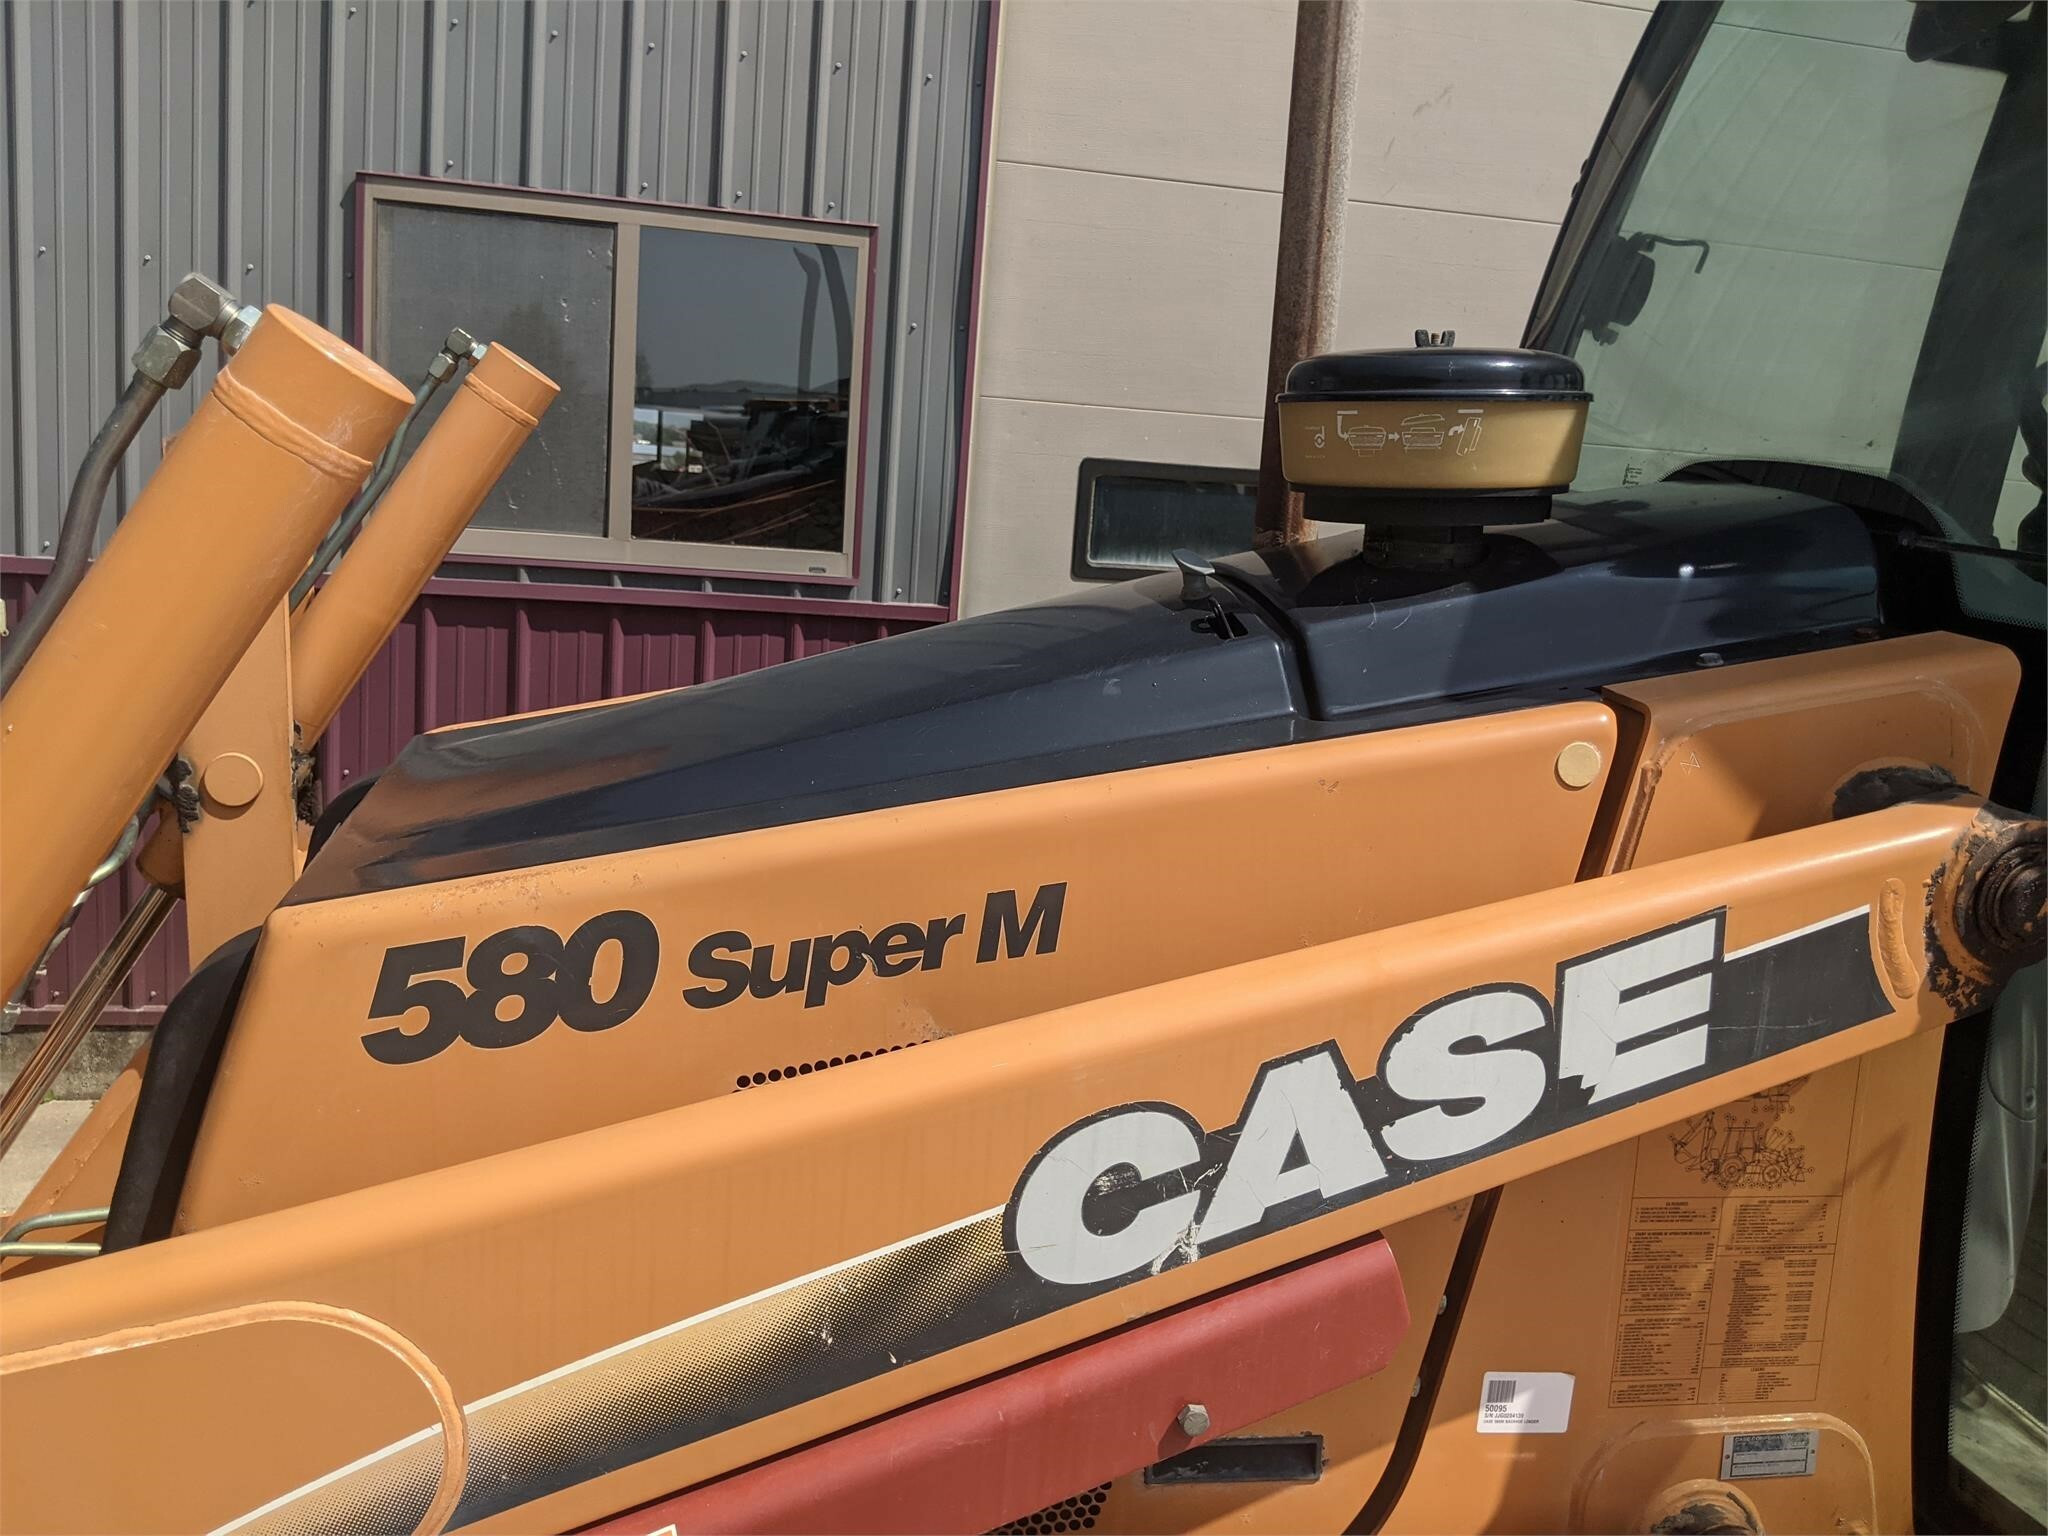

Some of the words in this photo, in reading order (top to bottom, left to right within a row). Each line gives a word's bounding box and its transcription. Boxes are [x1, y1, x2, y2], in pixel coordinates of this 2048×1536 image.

[361, 909, 660, 1065] 580
[683, 913, 967, 1010] Super
[976, 882, 1068, 964] M
[1010, 912, 1722, 1288] CASE
[1485, 1404, 1507, 1412] 50095
